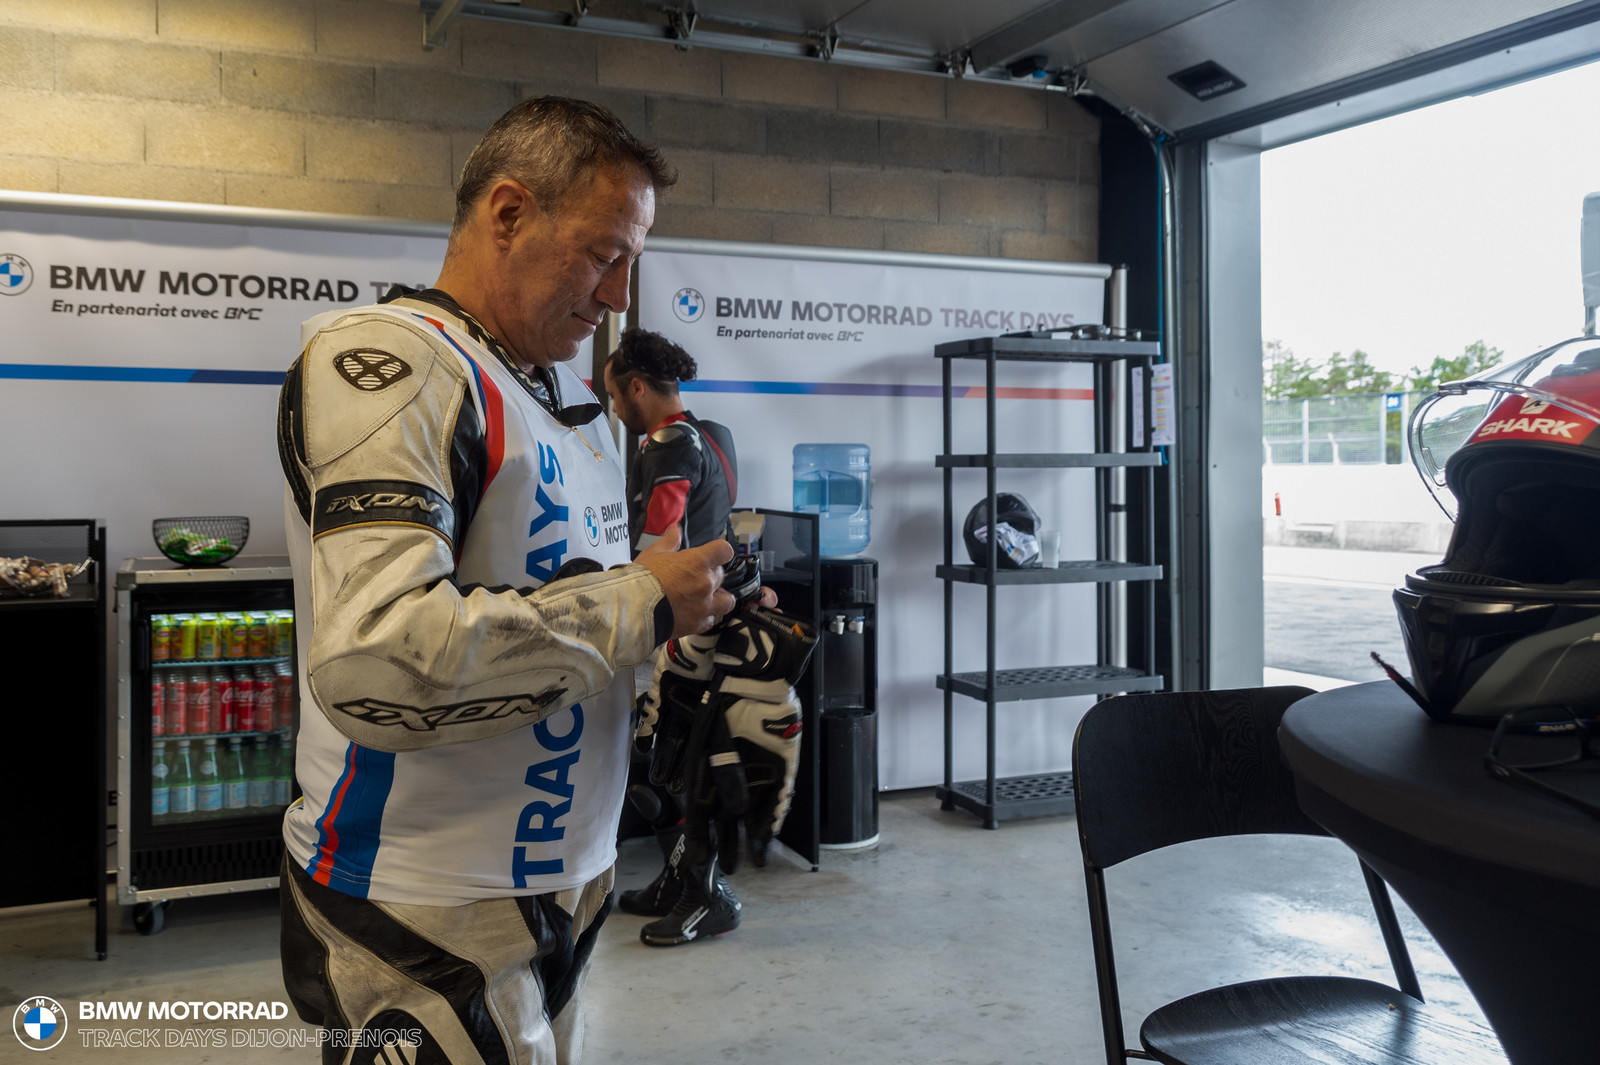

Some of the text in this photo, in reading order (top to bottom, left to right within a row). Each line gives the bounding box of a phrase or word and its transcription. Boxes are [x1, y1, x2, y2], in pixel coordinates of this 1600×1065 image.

[50, 265, 146, 293] BMW
[159, 270, 359, 303] MOTORRAD
[52, 299, 73, 313] En
[77, 303, 177, 318] partenariat
[180, 308, 219, 320] avec
[716, 296, 1075, 330] BMW MOTORRAD TRACK DAYS
[716, 325, 733, 338] En
[734, 327, 804, 341] partenariat
[807, 330, 834, 341] avec
[1478, 417, 1580, 438] SHARK
[600, 501, 622, 522] BMW
[512, 440, 584, 889] TRAC AYS
